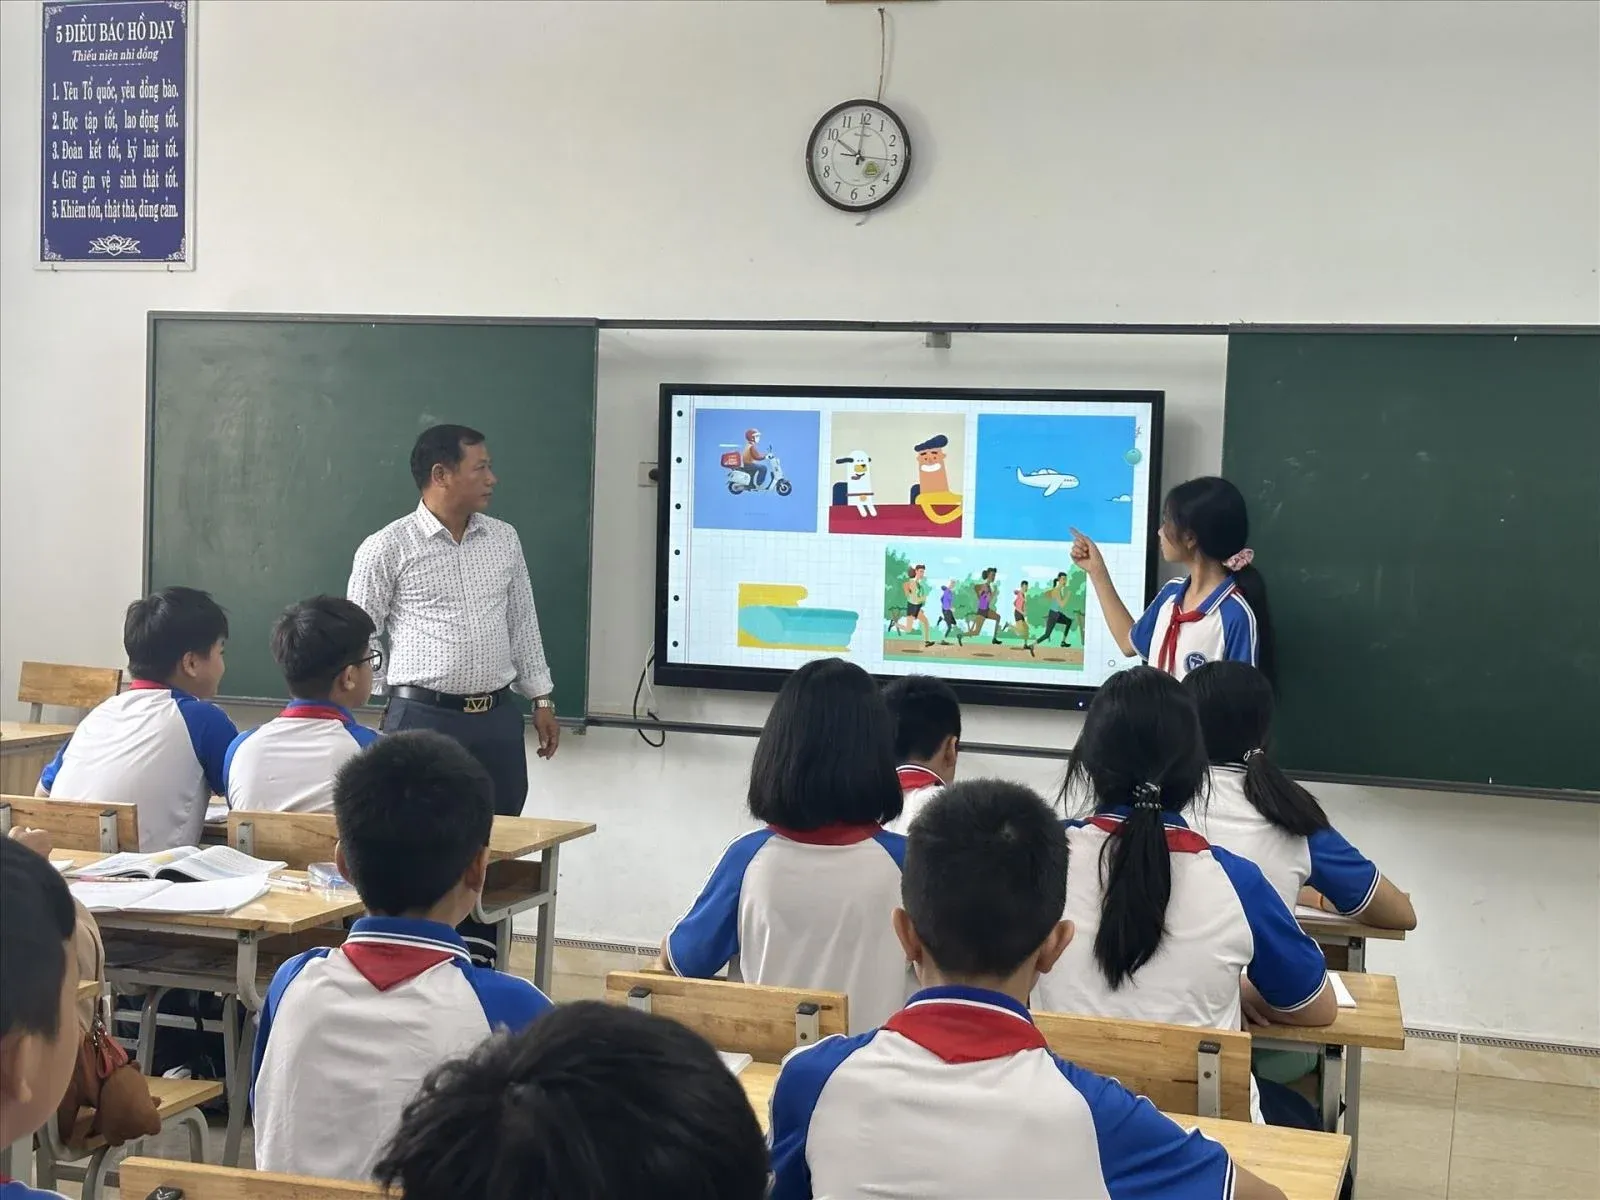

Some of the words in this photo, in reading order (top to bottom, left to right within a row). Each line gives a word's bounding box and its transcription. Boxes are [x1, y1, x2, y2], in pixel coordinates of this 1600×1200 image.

[55, 25, 63, 43] 5
[65, 14, 96, 42] ĐIỀU
[99, 17, 125, 41] BÁC
[127, 12, 146, 40] HỒ
[150, 20, 175, 44] DẠY
[99, 49, 118, 60] niên
[120, 48, 135, 60] nhi
[52, 83, 60, 100] 1.
[63, 81, 78, 100] Yêu
[82, 76, 93, 100] Tổ
[96, 78, 118, 104] quốc,
[121, 80, 136, 104] yêu
[162, 78, 178, 98] bào.
[52, 112, 60, 130] 2.
[62, 111, 78, 135] Học
[84, 111, 98, 134] tập
[104, 107, 118, 133] tốt,
[124, 110, 136, 130] lao
[140, 110, 159, 133] động
[165, 106, 178, 128] tốt.
[842, 116, 852, 128] 11
[860, 112, 872, 126] 12
[880, 120, 884, 132] 1
[827, 128, 839, 141] 10
[889, 134, 896, 147] 2
[52, 141, 60, 160] 3.
[62, 140, 83, 160] Đoàn
[89, 138, 102, 159] kết
[108, 138, 122, 162] tốt,
[144, 139, 159, 163] luật
[165, 136, 178, 158] tốt.
[821, 146, 828, 159] 9
[890, 154, 898, 166] 3
[823, 166, 830, 178] 8
[882, 172, 890, 184] 4
[52, 171, 60, 189] 4.
[82, 170, 96, 193] gìn
[101, 170, 111, 193] vệ
[120, 170, 137, 188] sinh
[143, 169, 159, 192] thật
[165, 166, 178, 188] tốt.
[834, 181, 841, 194] 7
[850, 188, 858, 200] 6
[868, 184, 876, 197] 5
[52, 200, 59, 218] 5.
[60, 200, 86, 218] Khiêm
[88, 196, 102, 222] tốn,
[104, 200, 121, 223] thật
[122, 200, 138, 222] thà,
